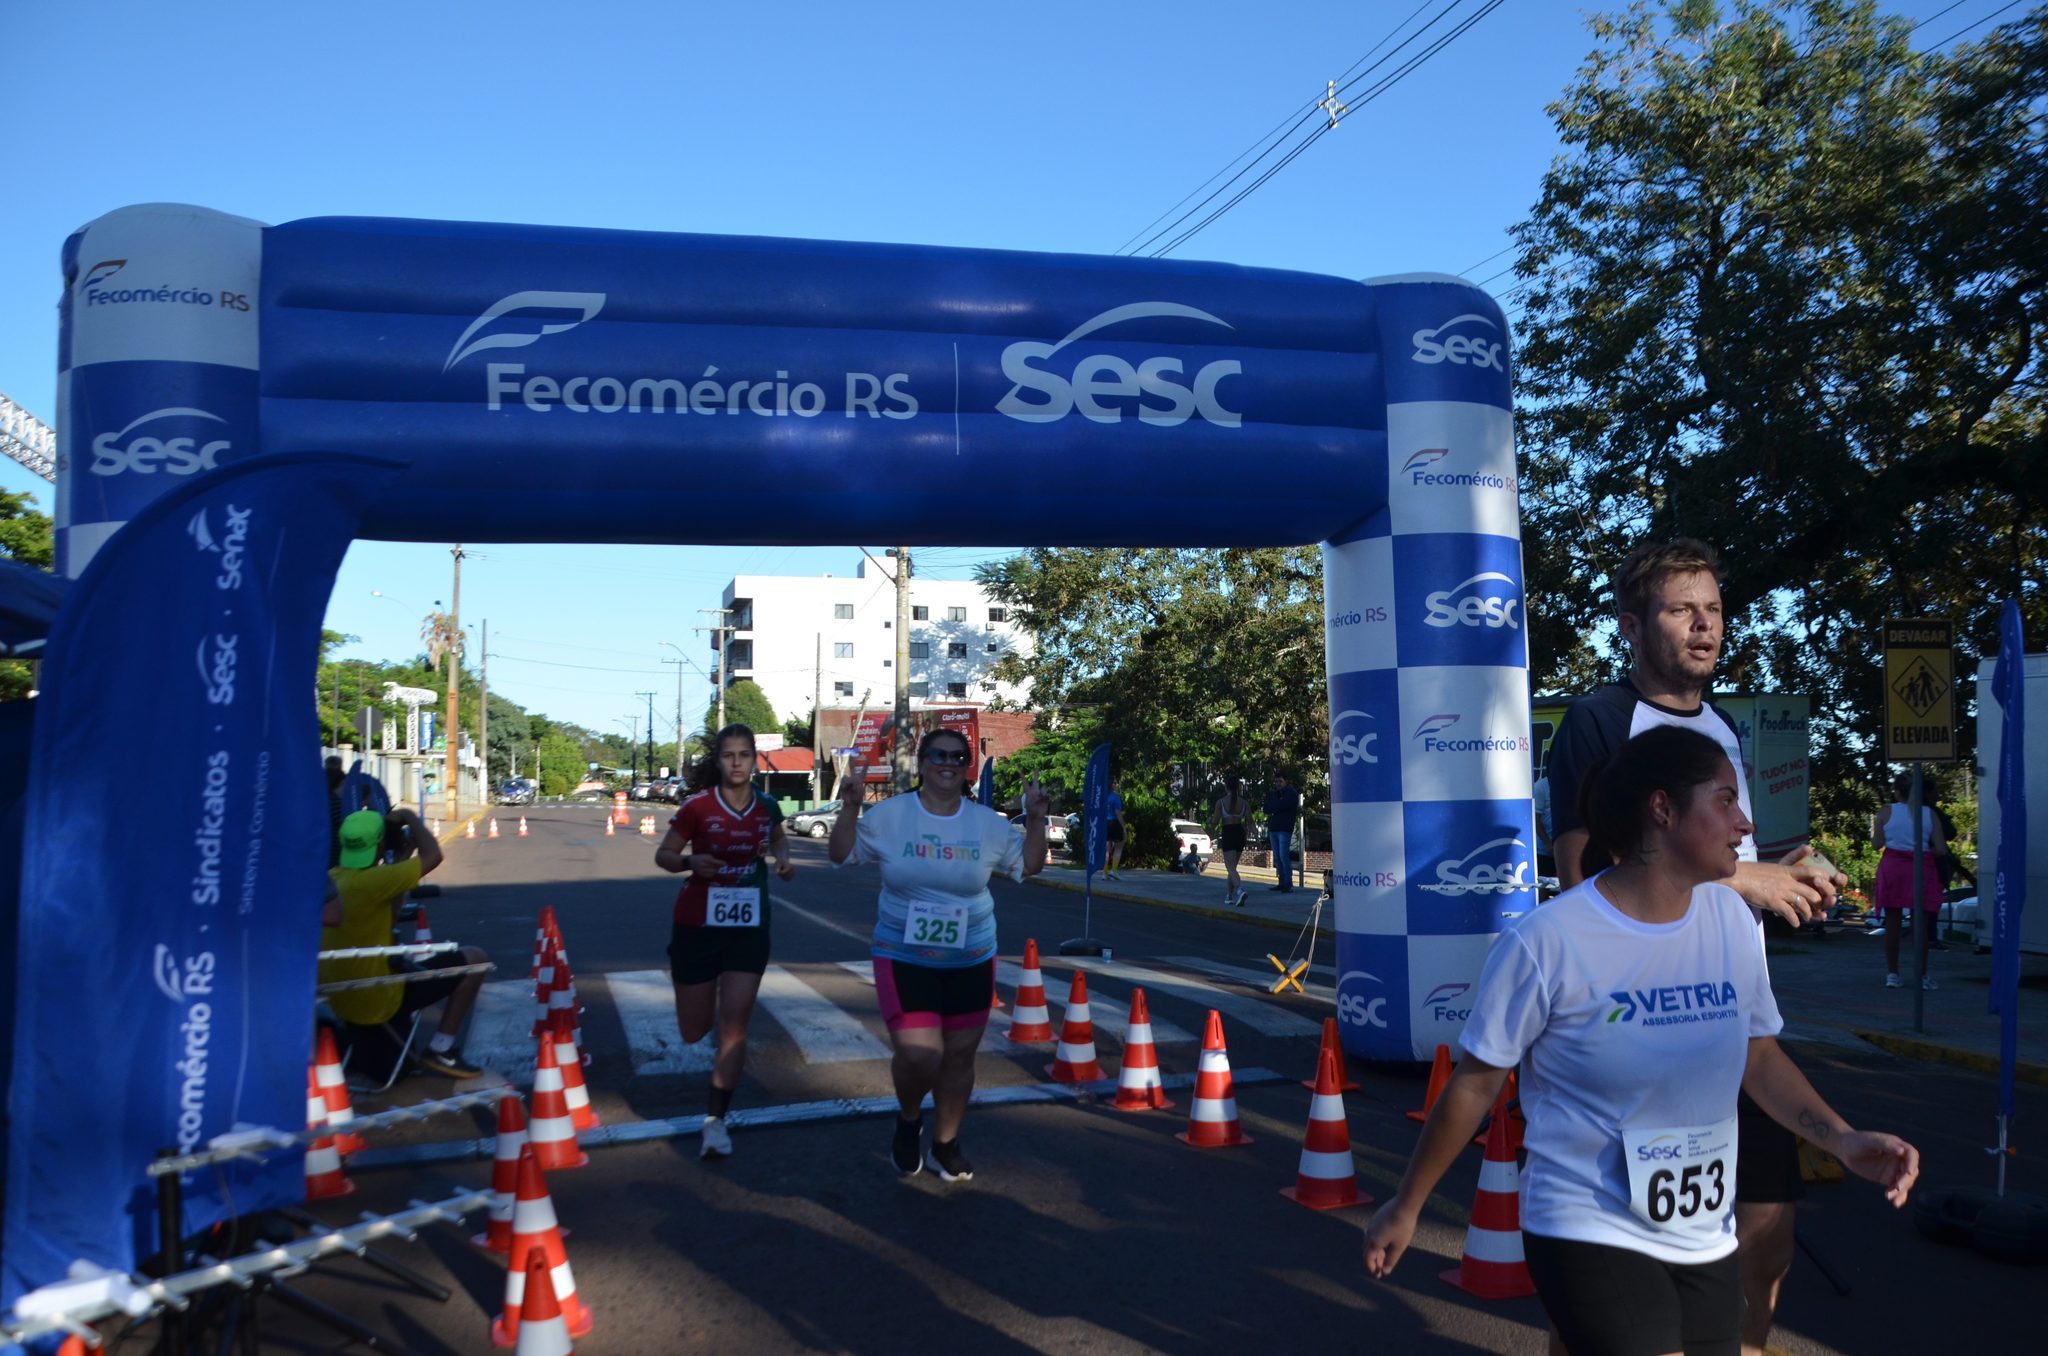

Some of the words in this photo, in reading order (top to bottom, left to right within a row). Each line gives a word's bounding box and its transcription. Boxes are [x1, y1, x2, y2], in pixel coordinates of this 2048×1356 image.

[88, 284, 213, 307] Fecomércio
[220, 291, 250, 312] RS
[1411, 328, 1503, 372] Sesc
[485, 362, 826, 418] Fecomércio
[846, 372, 919, 420] RS
[996, 341, 1242, 427] Sesc
[89, 431, 231, 476] Sesc
[1412, 470, 1503, 489] Fecomércio
[1505, 472, 1517, 492] RS
[216, 503, 252, 591] Senac
[1329, 611, 1362, 629] mércio
[1365, 606, 1388, 623] RS
[1423, 591, 1518, 630] Sesc
[1888, 628, 1947, 644] DEVAGAR
[206, 633, 238, 706] Sesc
[1331, 733, 1378, 766] esc
[1425, 735, 1516, 752] Fecomércio
[1518, 736, 1530, 752] RS
[1892, 726, 1949, 745] ELEVADA
[1760, 762, 1788, 781] TUDO
[1769, 775, 1804, 796] ESPETO
[248, 750, 271, 835] Comércio
[192, 749, 229, 906] Sindicatos
[902, 841, 980, 861] Autismo
[1334, 871, 1371, 888] mércio
[1375, 872, 1398, 888] RS
[1434, 859, 1528, 896] Sesc
[714, 902, 753, 924] 646
[913, 916, 959, 944] 325
[184, 950, 215, 996] RS
[1338, 993, 1387, 1028] esc
[1634, 981, 1737, 1012] VETRIA
[1642, 1013, 1700, 1026] ASSESSORIA
[176, 1001, 213, 1184] comércio
[1637, 1143, 1682, 1161] Sesc
[1648, 1158, 1725, 1223] 653
